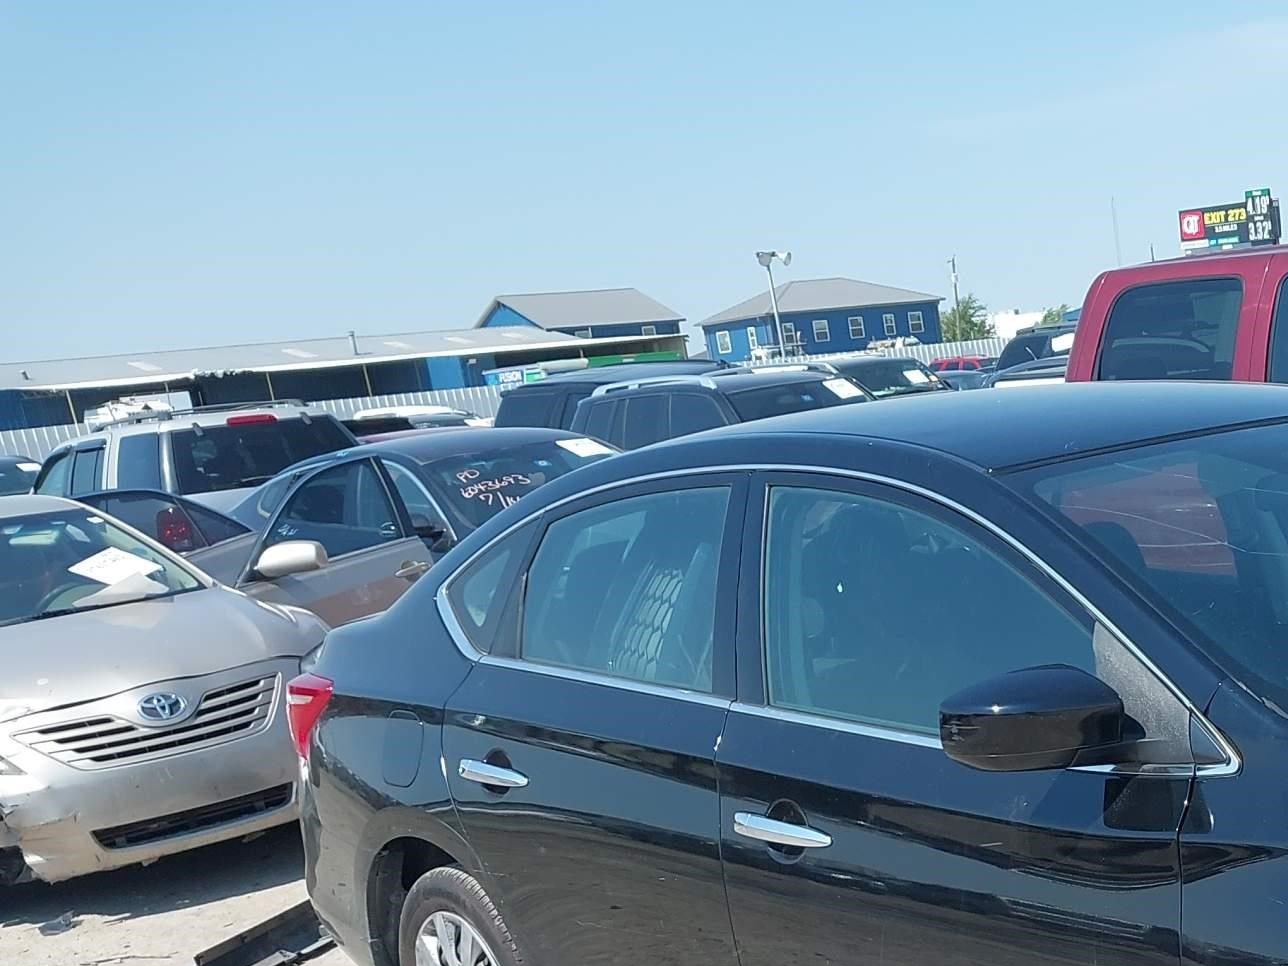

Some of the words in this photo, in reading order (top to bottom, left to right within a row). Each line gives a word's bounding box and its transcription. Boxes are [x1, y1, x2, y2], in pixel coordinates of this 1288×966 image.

[1203, 209, 1226, 225] EXIT
[1227, 207, 1247, 221] 273
[456, 469, 480, 483] PD
